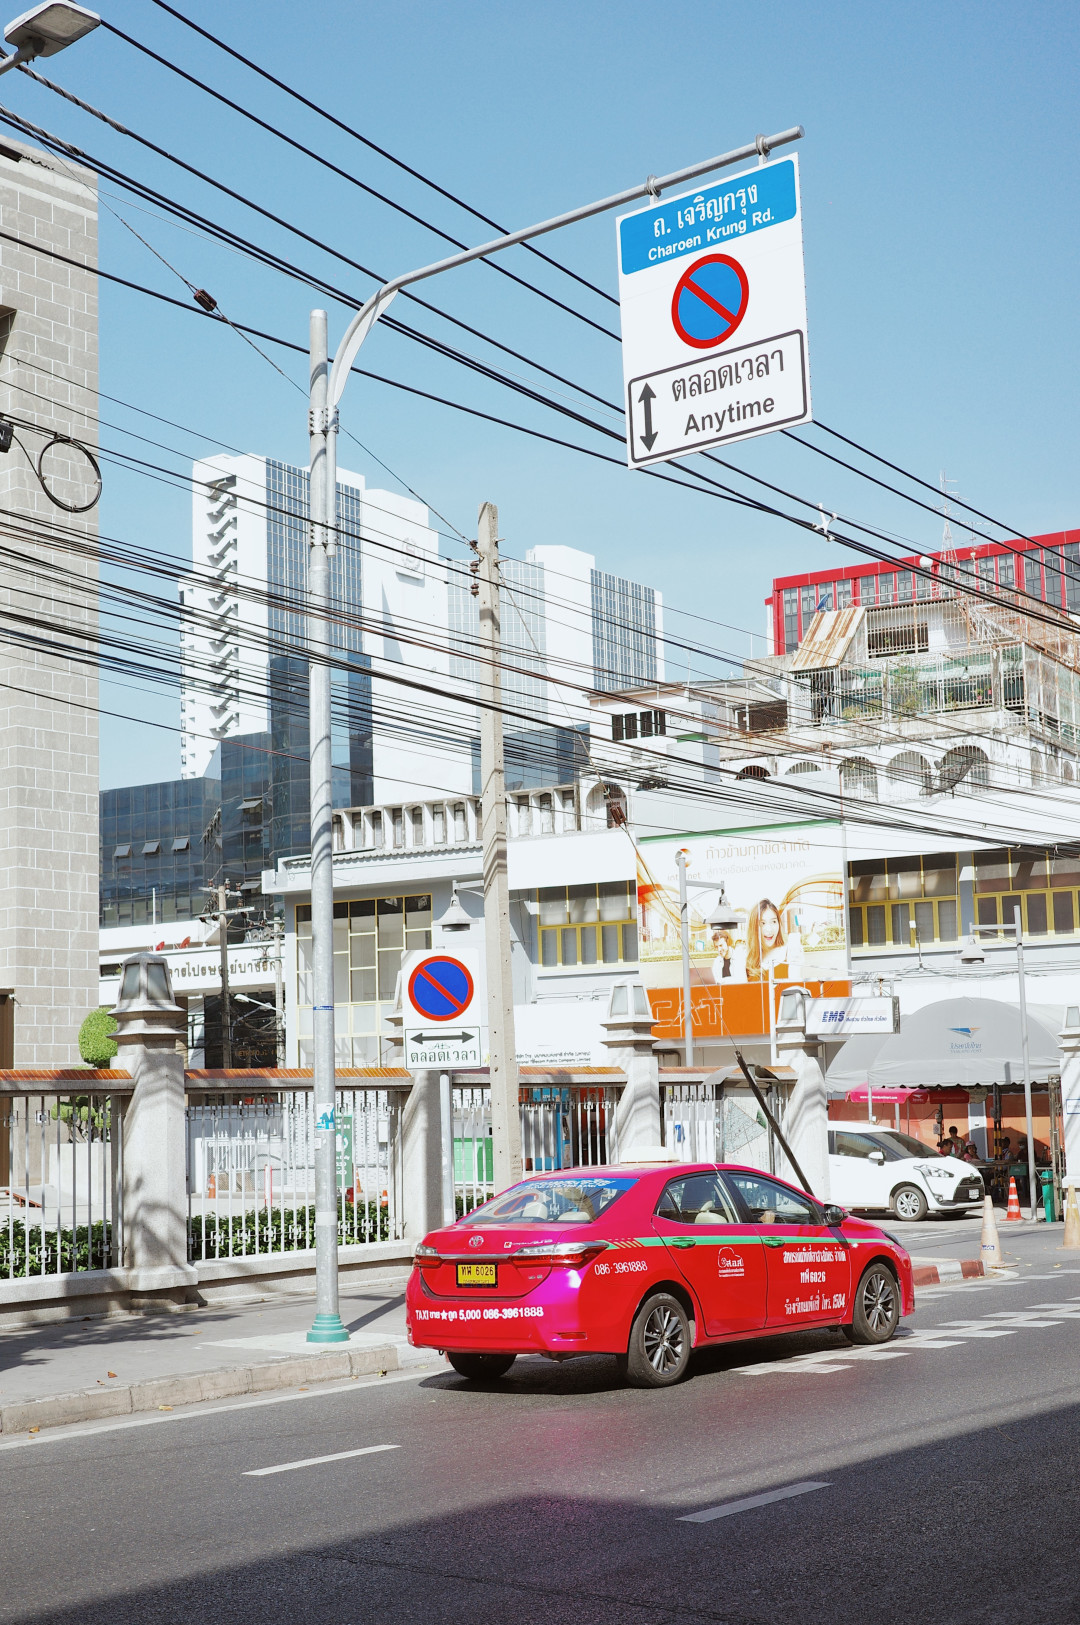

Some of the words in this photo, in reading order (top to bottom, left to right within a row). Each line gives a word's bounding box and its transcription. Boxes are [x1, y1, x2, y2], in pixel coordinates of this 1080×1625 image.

[653, 218, 672, 238] ถ.
[677, 183, 758, 229] เจริญกรุง
[648, 235, 701, 261] Charoen
[706, 220, 747, 242] Krung
[752, 207, 775, 225] Rd.
[672, 349, 784, 402] ตลอดเวลา
[684, 397, 775, 436] Anytime
[667, 872, 700, 881] intnet
[650, 998, 723, 1028] CAT
[822, 1011, 845, 1022] EMS
[410, 1050, 476, 1062] ตลอดเวลา
[476, 1266, 494, 1276] 6026
[810, 1271, 826, 1283] 6026
[832, 1293, 845, 1309] 1584
[415, 1310, 429, 1320] TAXI
[459, 1309, 481, 1322] 5,000
[483, 1306, 544, 1319] 086-3961888
